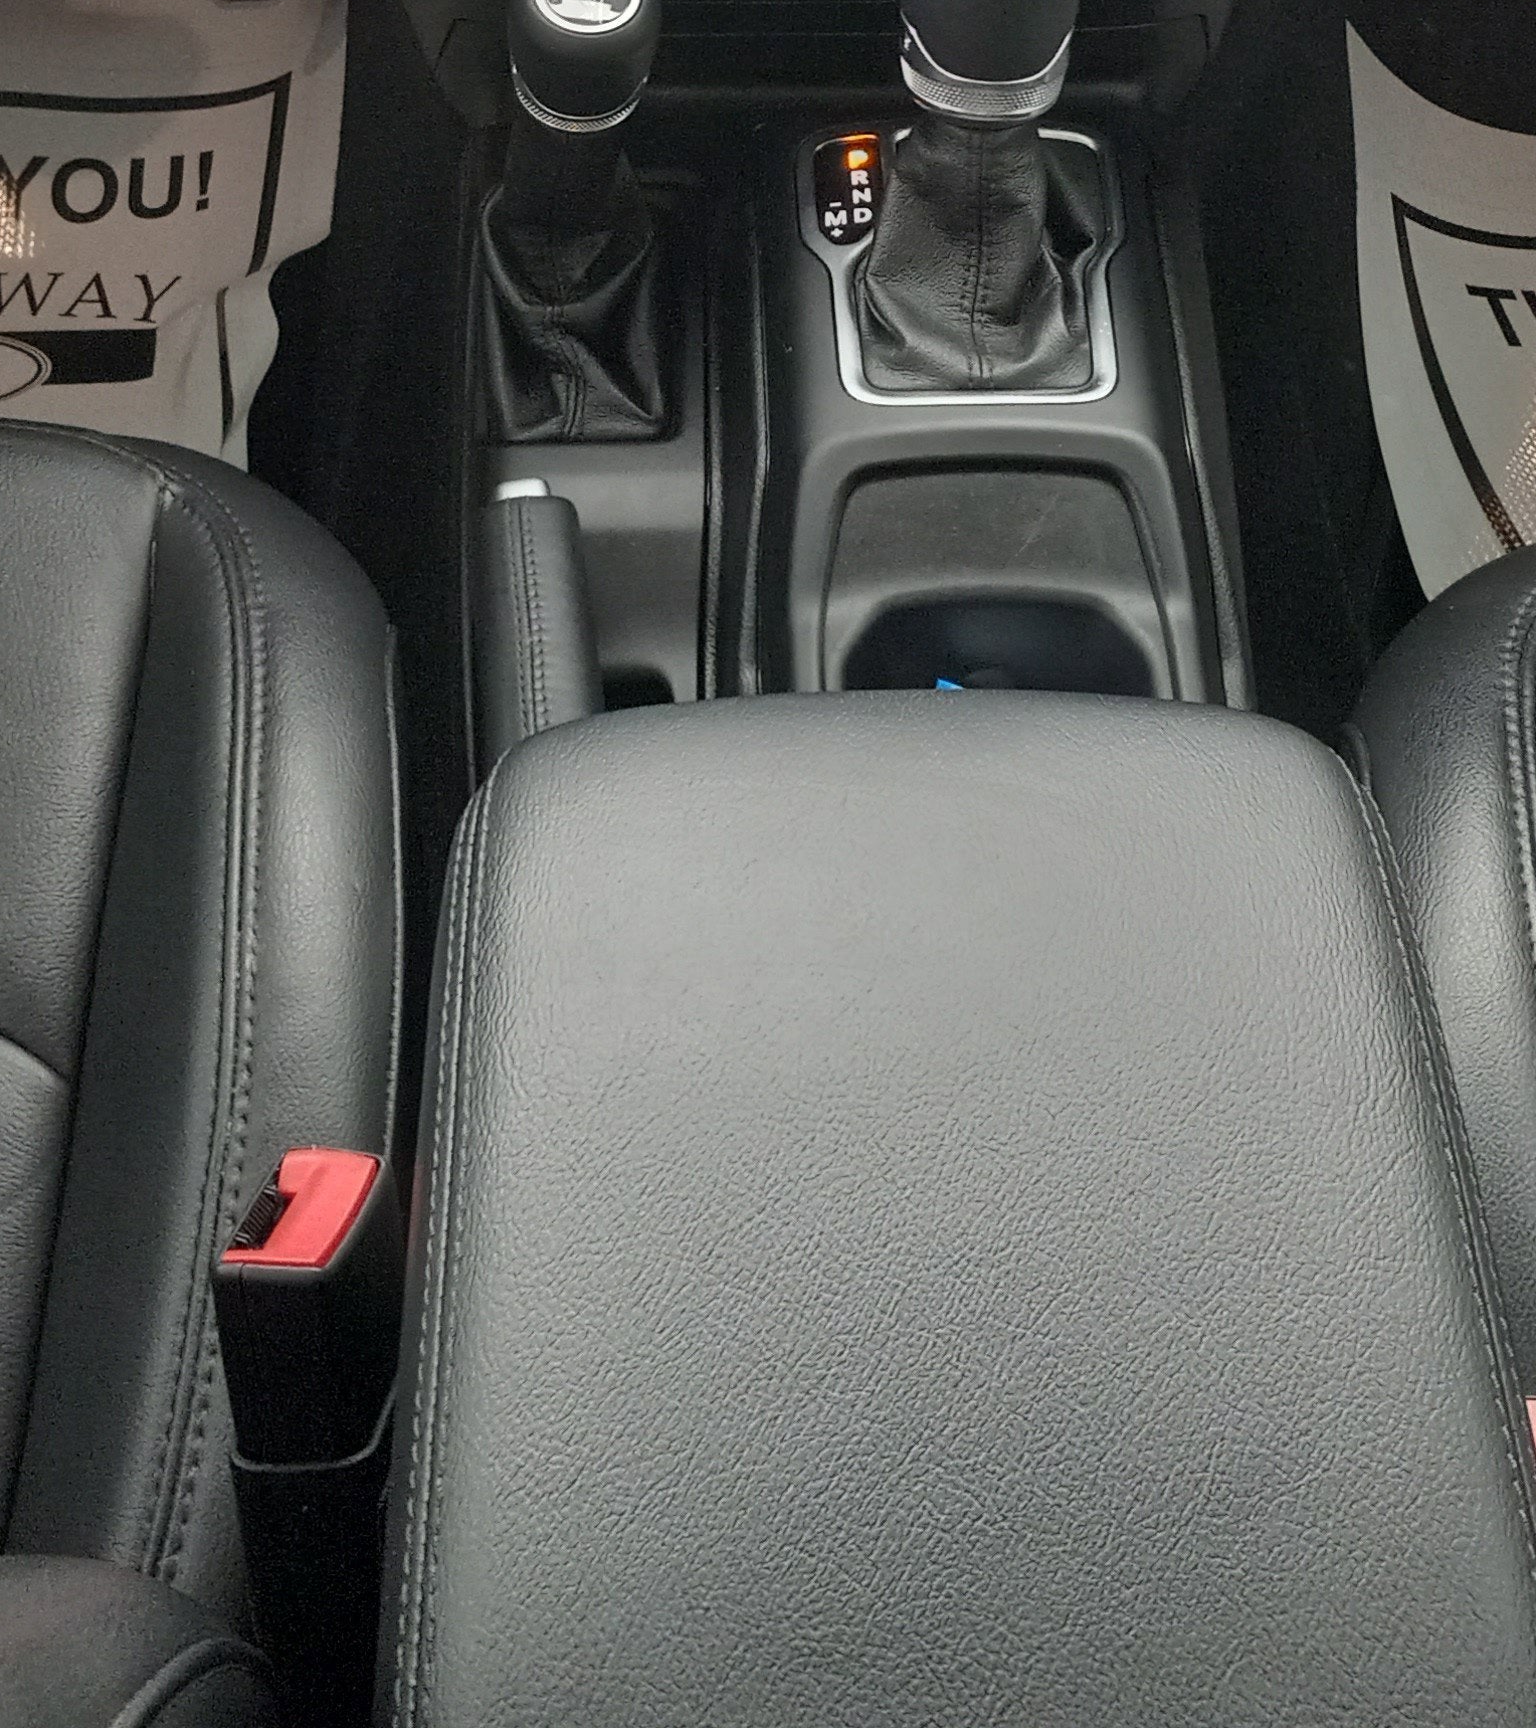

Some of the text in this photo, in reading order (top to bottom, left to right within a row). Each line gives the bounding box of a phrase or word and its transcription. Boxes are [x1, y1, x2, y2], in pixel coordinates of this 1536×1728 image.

[847, 149, 869, 169] P
[850, 169, 869, 186] R
[852, 187, 872, 204] N
[824, 210, 848, 227] M
[853, 207, 873, 224] D
